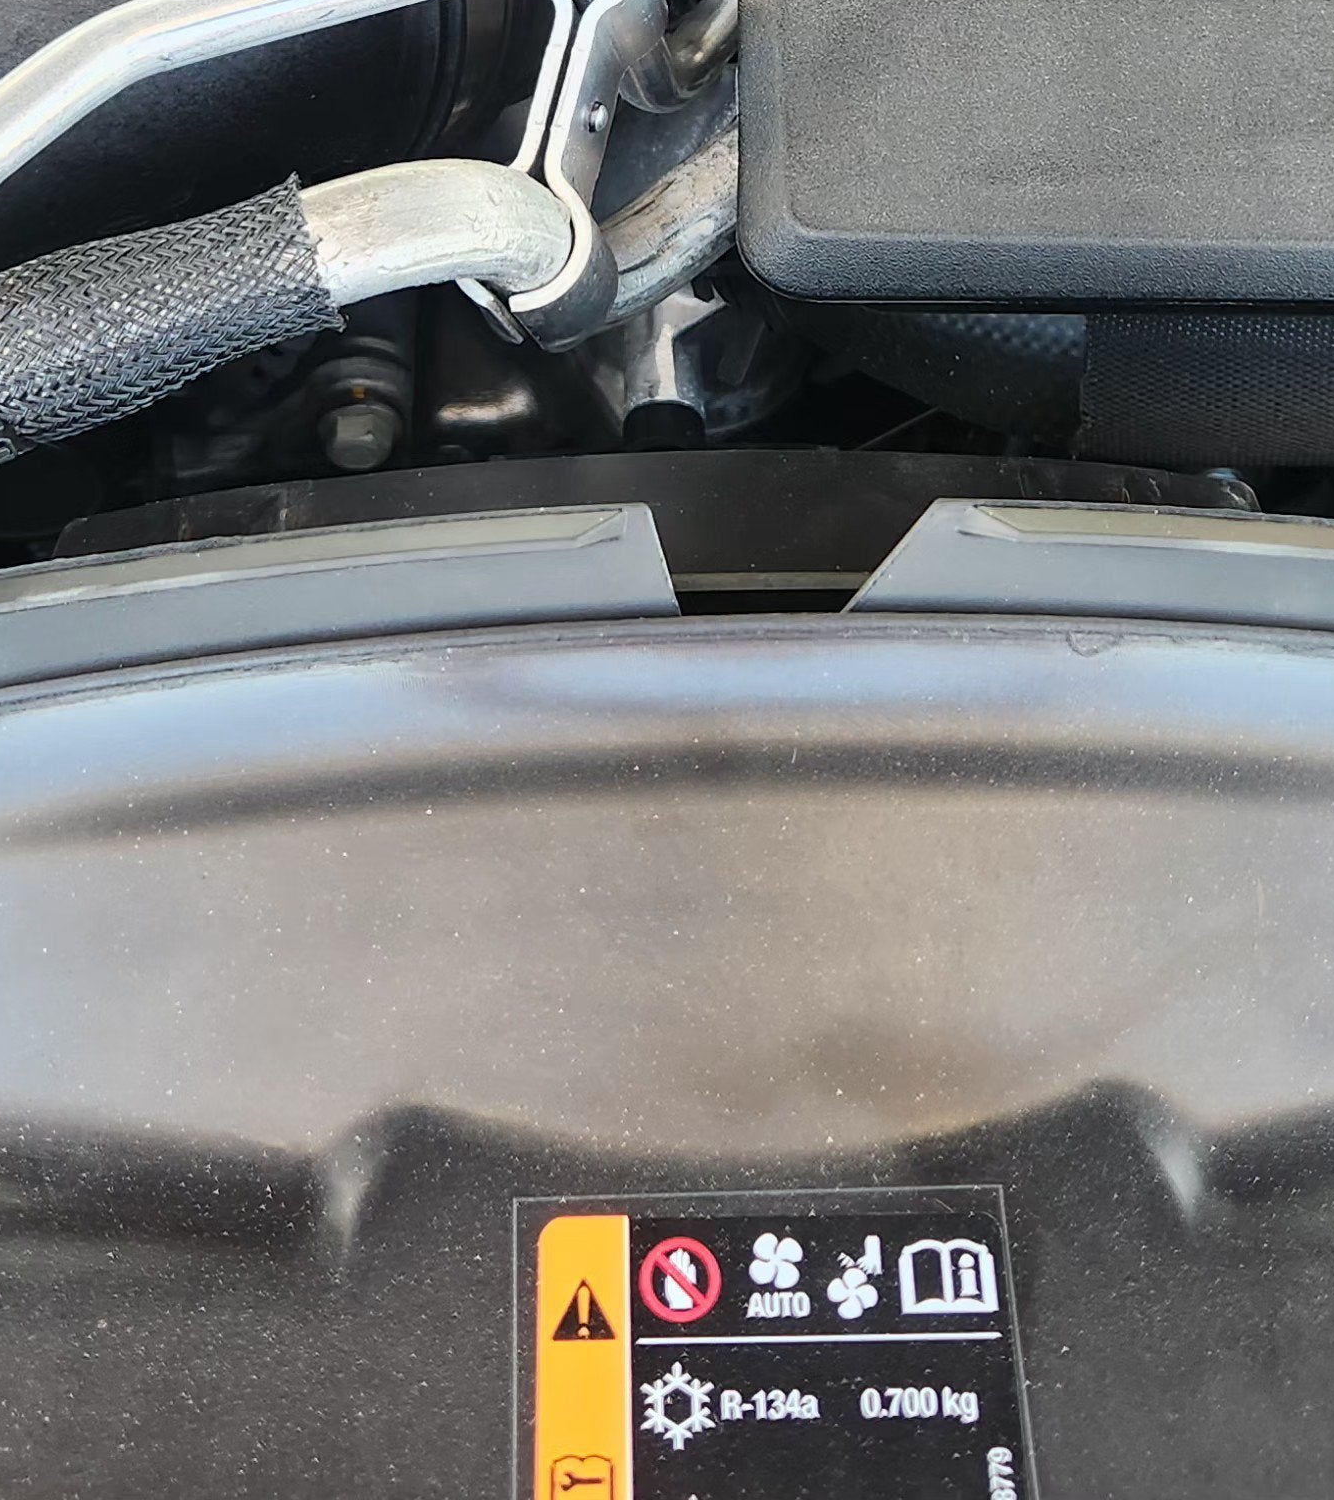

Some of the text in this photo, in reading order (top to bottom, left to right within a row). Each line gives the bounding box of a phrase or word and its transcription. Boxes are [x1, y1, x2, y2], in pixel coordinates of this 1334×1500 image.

[746, 1292, 811, 1318] AUTO
[720, 1386, 979, 1424] R-134a 0.700 kg
